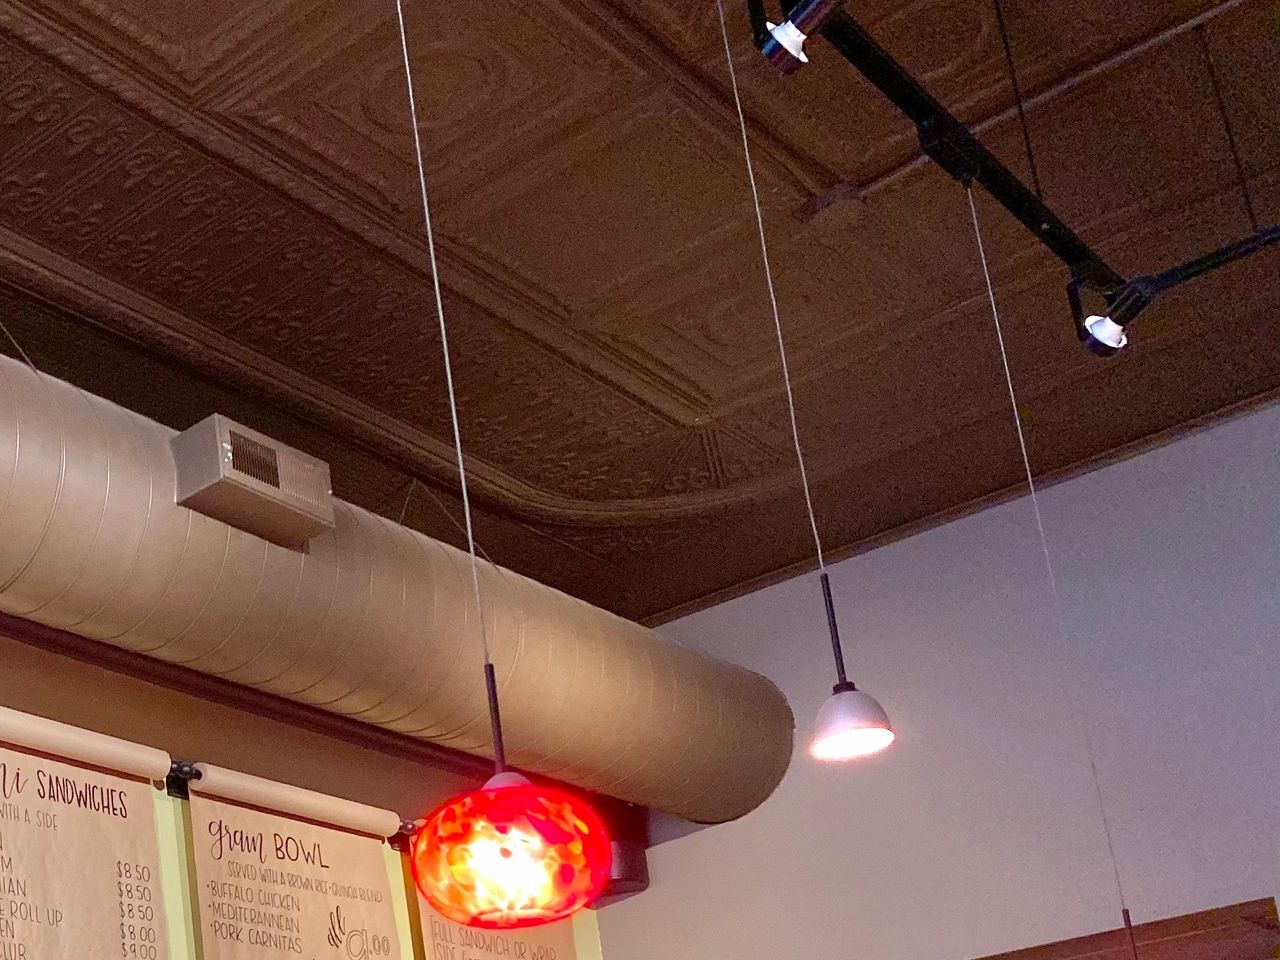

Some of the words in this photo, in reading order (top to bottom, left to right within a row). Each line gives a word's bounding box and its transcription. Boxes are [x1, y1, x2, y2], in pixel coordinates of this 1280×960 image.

[37, 769, 127, 818] SANDWICHES
[274, 833, 329, 869] BOWL
[214, 922, 243, 944] PORK
[249, 927, 302, 954] CARNITAS
